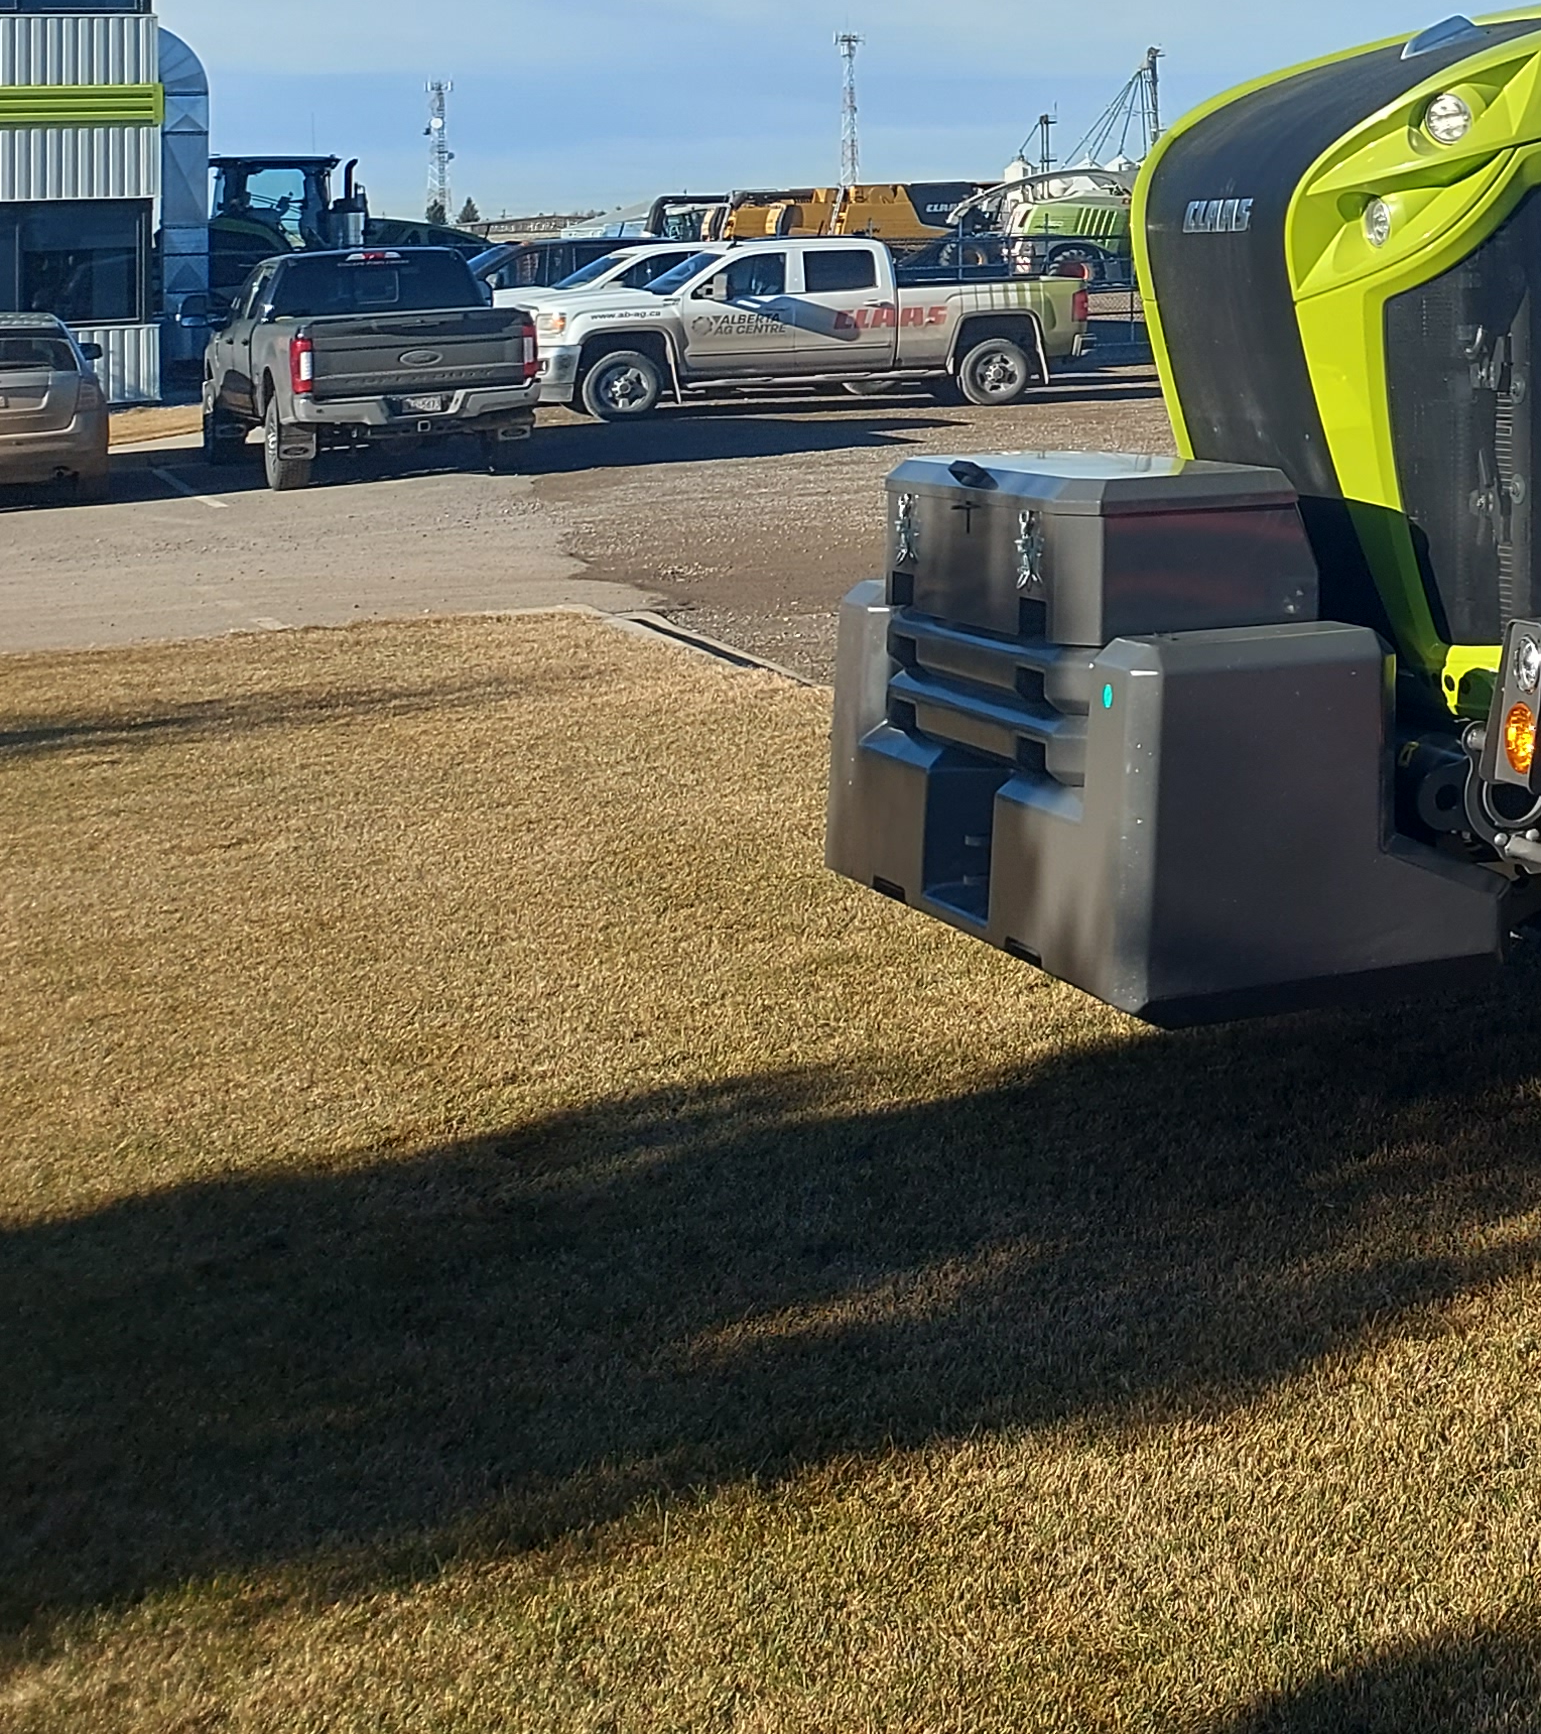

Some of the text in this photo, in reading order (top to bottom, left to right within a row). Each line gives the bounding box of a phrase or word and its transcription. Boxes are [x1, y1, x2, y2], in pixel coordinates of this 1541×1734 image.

[1182, 197, 1254, 234] CLAAS
[590, 310, 661, 321] www.ab-ag.ca
[719, 312, 781, 325] ALBERTA
[834, 306, 948, 329] CLAAS
[714, 323, 786, 336] AG CENTRE
